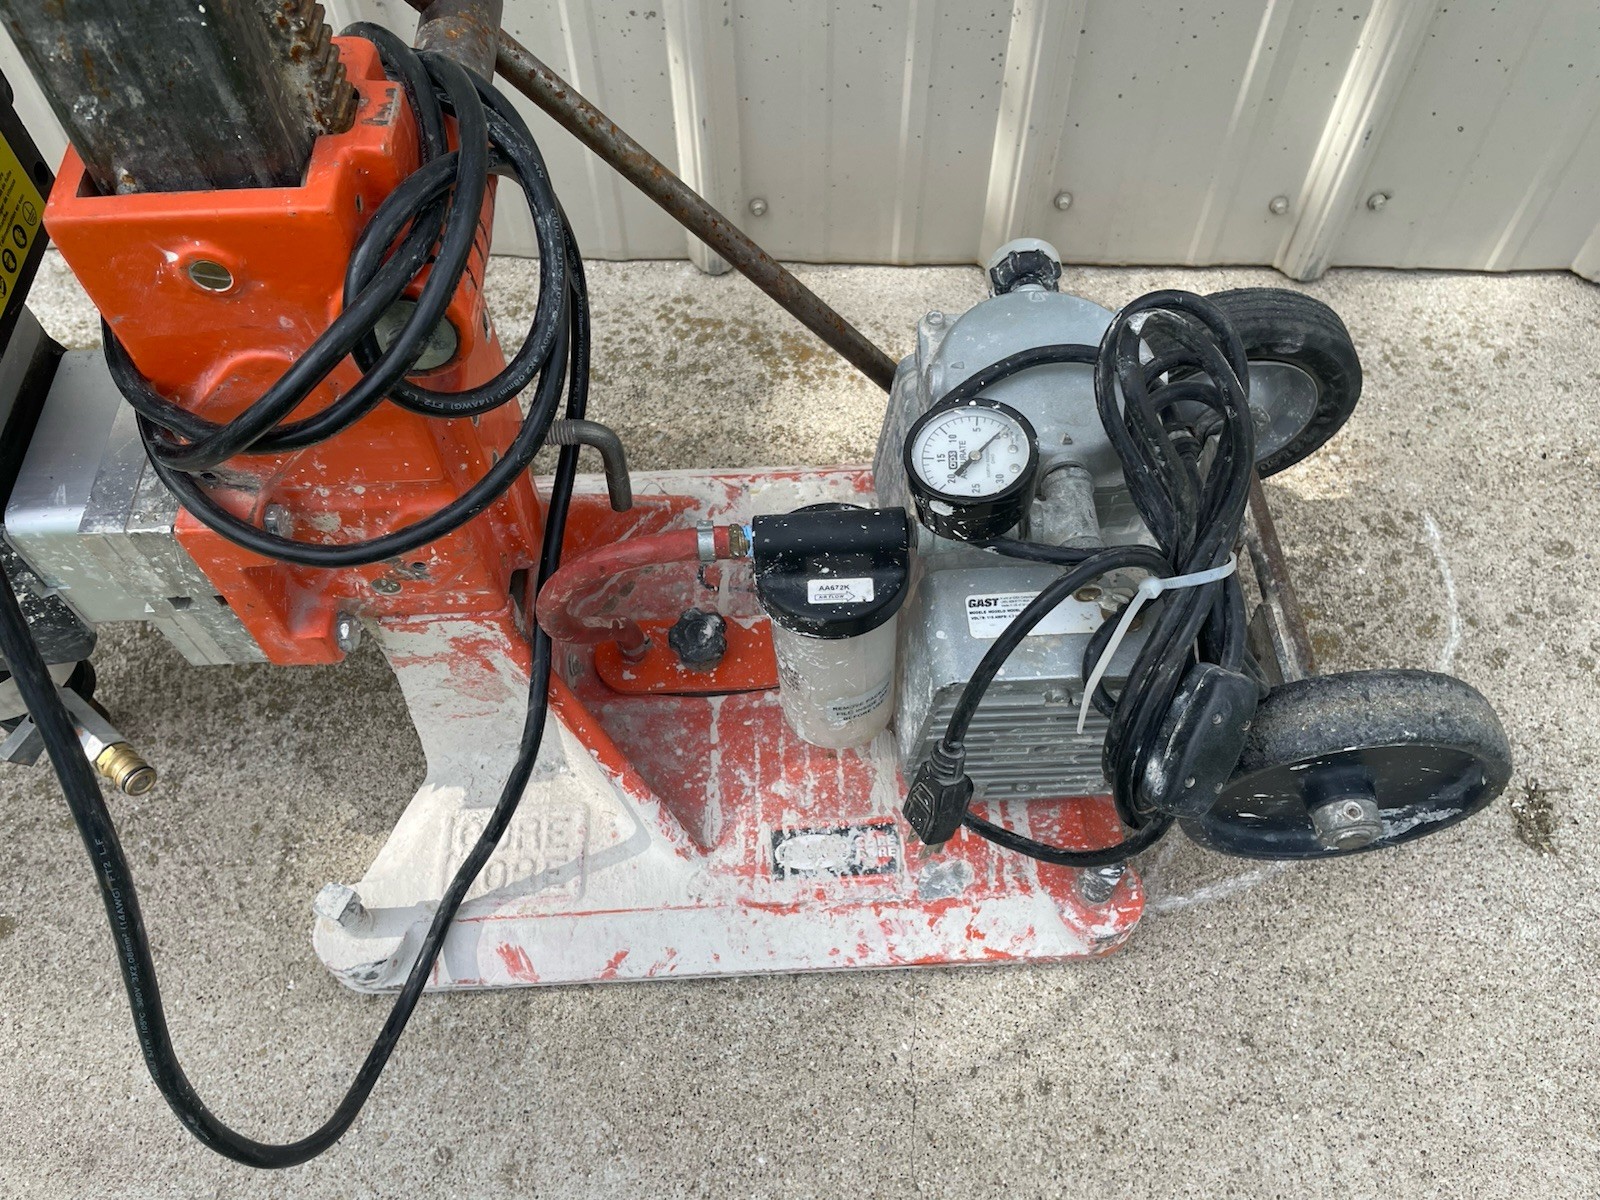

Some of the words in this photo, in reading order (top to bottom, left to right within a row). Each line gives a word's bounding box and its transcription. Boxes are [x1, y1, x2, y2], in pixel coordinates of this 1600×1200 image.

[949, 434, 958, 443] 10
[937, 453, 946, 463] 15
[958, 440, 968, 480] ACURATE
[947, 474, 957, 484] 20
[995, 474, 1005, 484] 30
[971, 483, 981, 494] 25
[968, 597, 999, 608] GAST
[832, 702, 864, 711] REMOVE
[102, 860, 115, 882] FT2
[133, 986, 145, 1008] 300V
